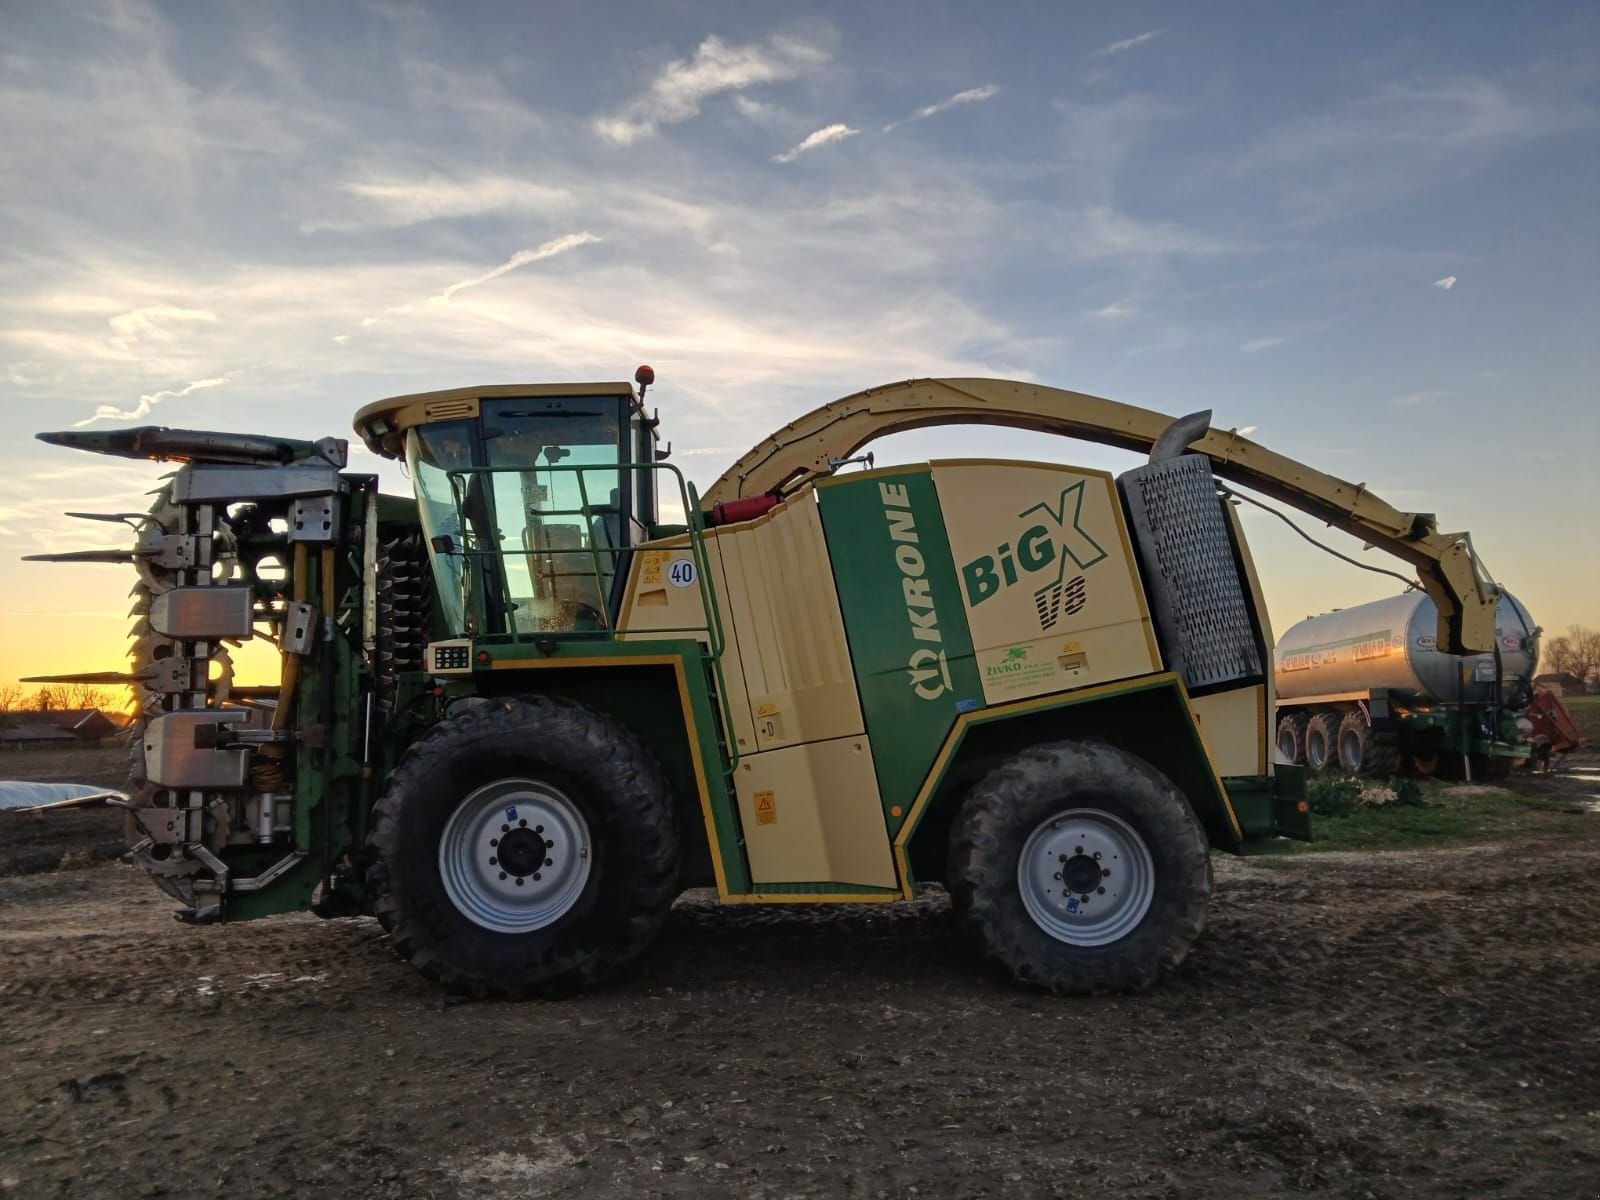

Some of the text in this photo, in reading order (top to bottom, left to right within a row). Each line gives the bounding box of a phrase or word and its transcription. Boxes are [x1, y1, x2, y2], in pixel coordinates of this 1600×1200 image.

[671, 563, 692, 583] 40
[878, 482, 942, 642] KRONE
[1035, 575, 1087, 631] V8
